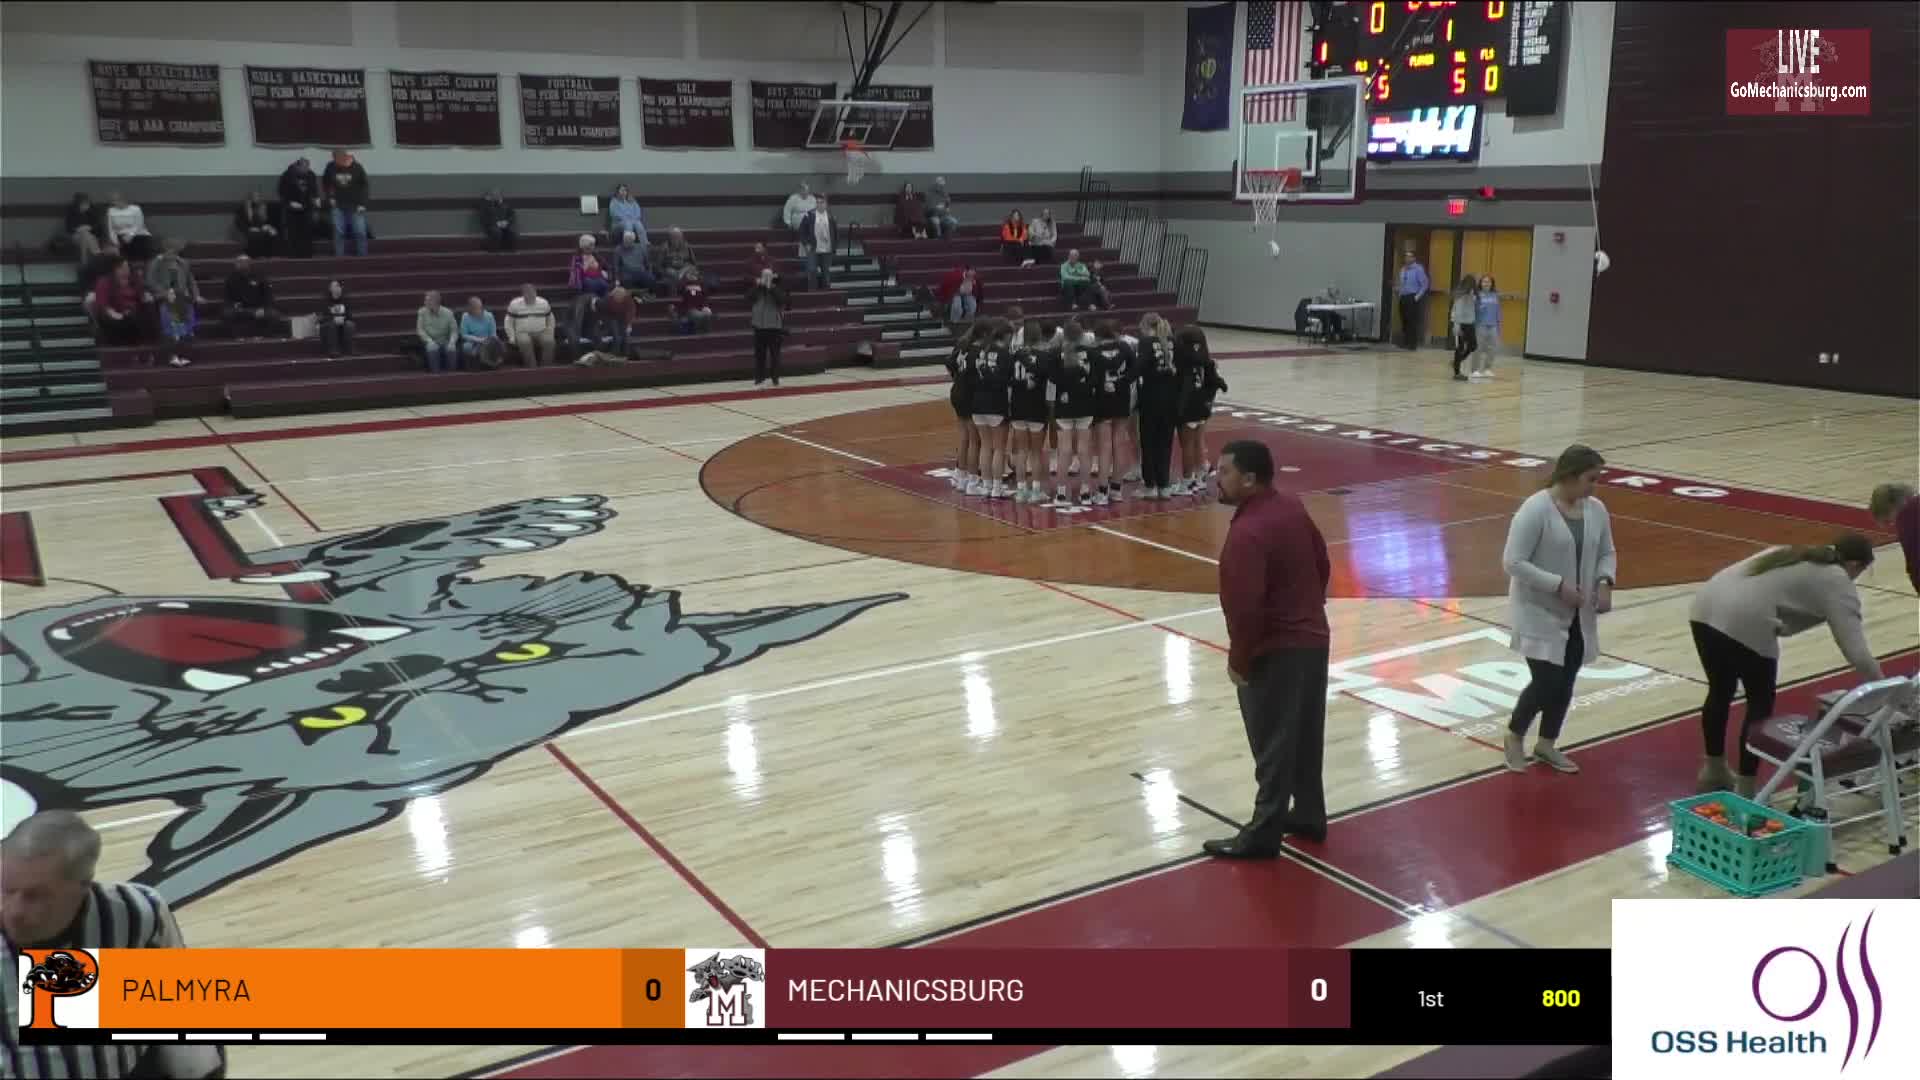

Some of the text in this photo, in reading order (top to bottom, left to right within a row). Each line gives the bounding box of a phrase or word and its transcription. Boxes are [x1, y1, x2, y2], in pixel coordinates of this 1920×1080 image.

[1371, 4, 1385, 33] 0
[292, 72, 360, 85] BASKETBALL
[547, 79, 593, 90] FOOTBALL
[1378, 76, 1389, 99] 5
[1453, 68, 1466, 93] 5
[1485, 66, 1498, 91] 0
